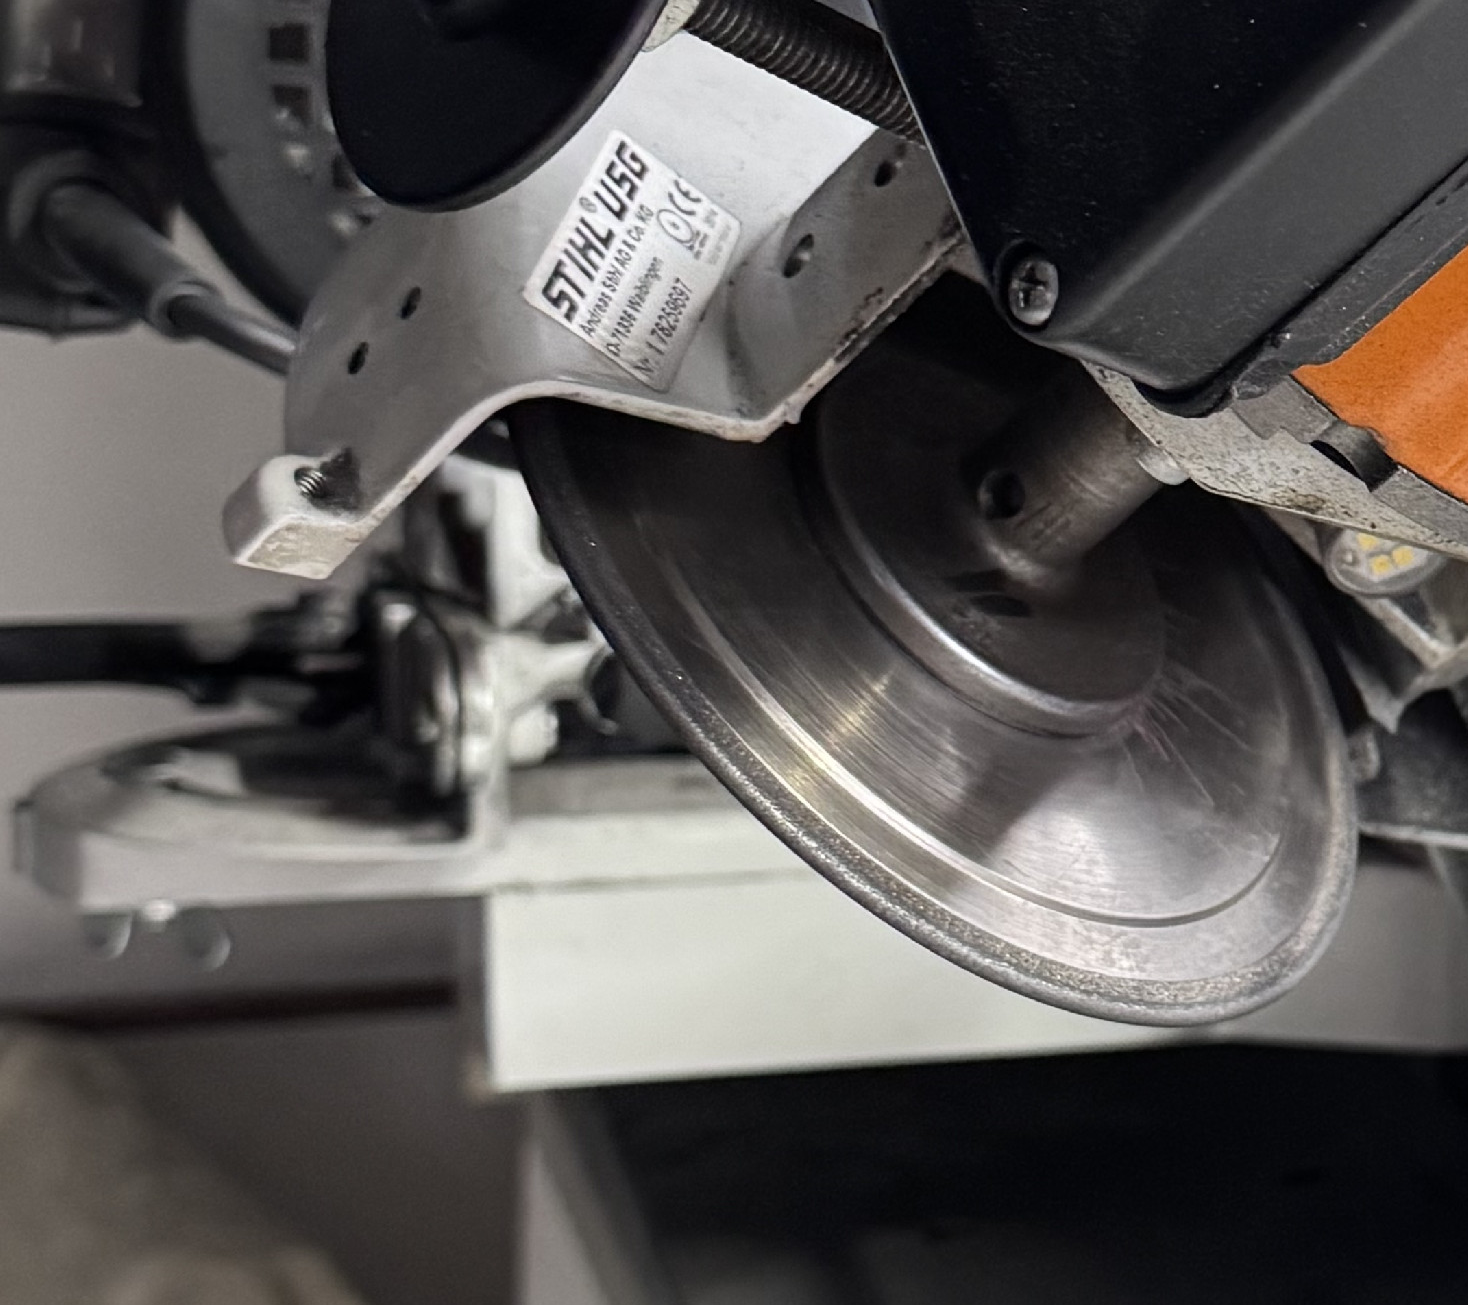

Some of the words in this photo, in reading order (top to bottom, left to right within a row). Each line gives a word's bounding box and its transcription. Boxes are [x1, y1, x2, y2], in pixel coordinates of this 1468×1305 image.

[593, 140, 649, 222] USG
[579, 291, 613, 337] Andreas
[613, 248, 633, 272] AG
[635, 203, 654, 225] KG
